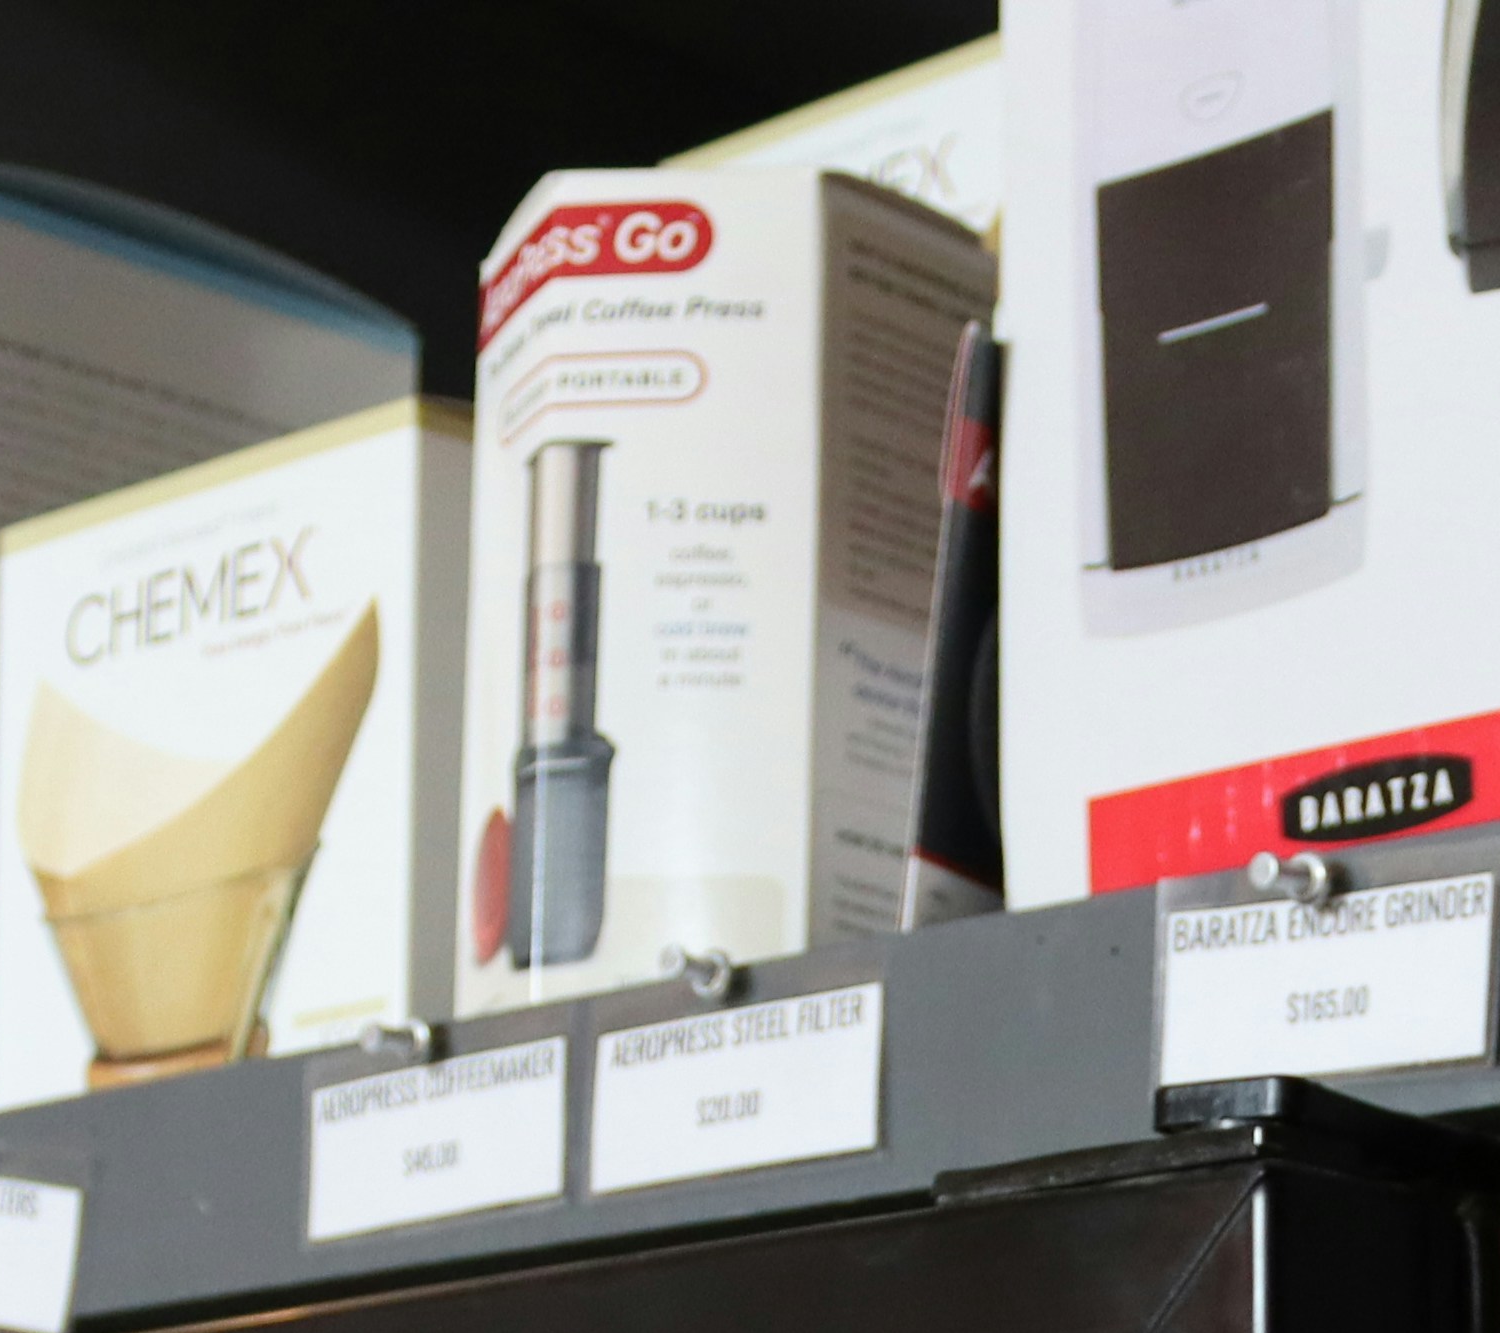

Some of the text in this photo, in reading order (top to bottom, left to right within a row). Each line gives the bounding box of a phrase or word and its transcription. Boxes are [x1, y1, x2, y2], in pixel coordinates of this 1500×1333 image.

[612, 210, 699, 265] Go
[646, 499, 767, 525] 1-3 cups
[65, 524, 318, 668] CHEMEX
[1298, 767, 1456, 833] BARATZA
[1172, 880, 1489, 952] BARATZA ENCORE GRINDER
[611, 995, 864, 1067] AEROPRESS STEEL FILTER
[1286, 984, 1370, 1025] $165.00
